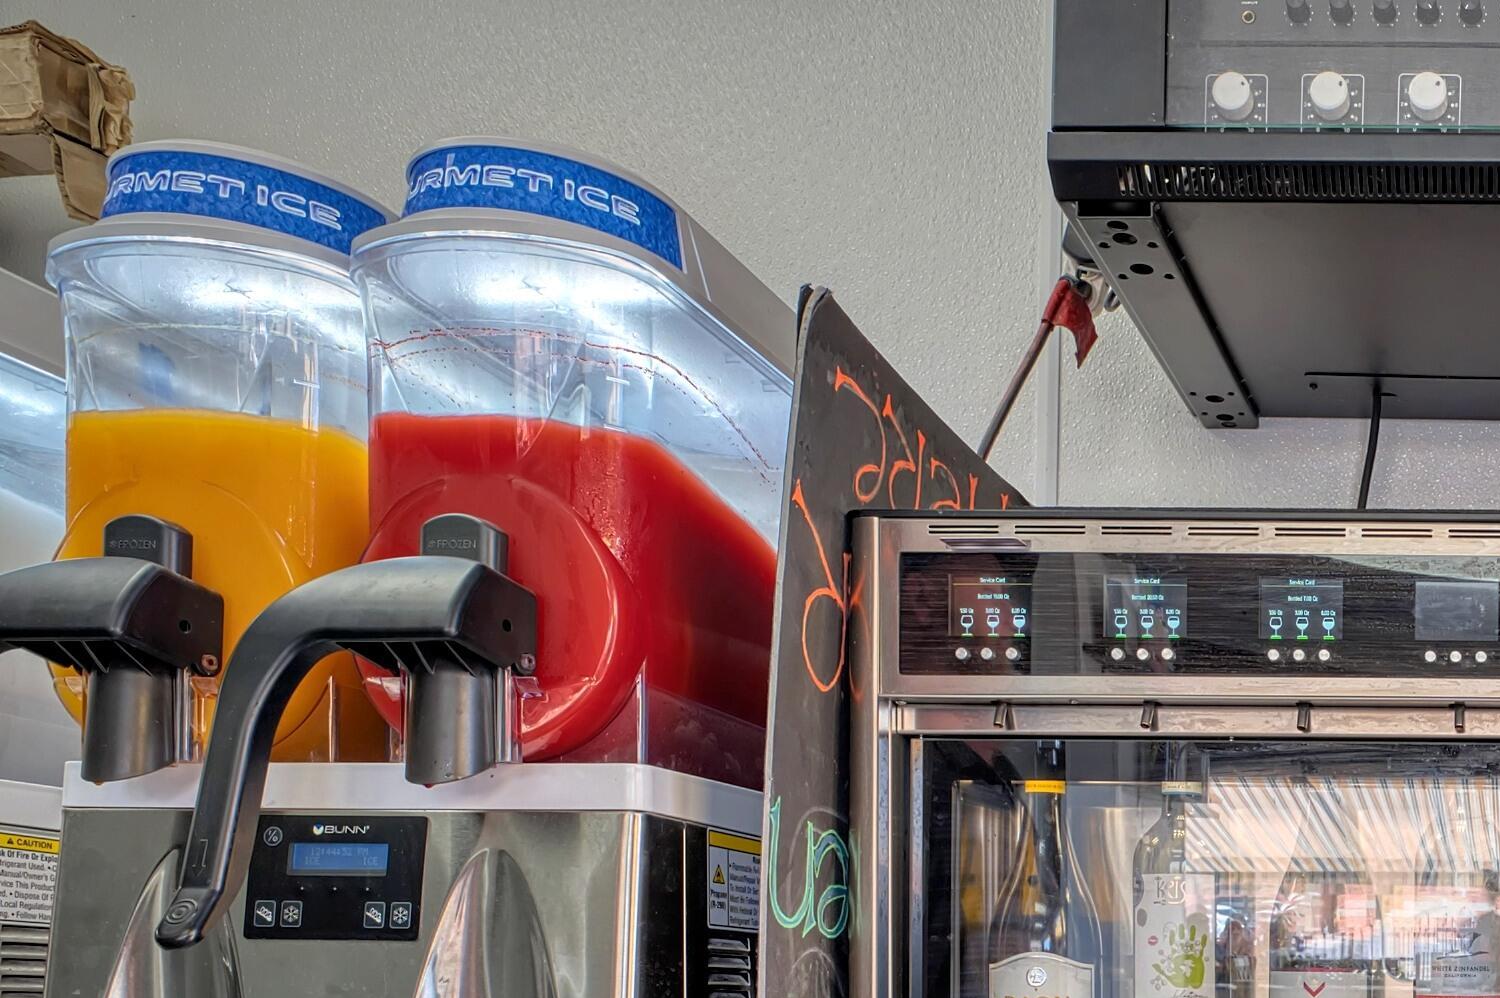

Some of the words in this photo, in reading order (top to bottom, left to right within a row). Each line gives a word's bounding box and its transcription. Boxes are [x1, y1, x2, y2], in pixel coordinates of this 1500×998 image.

[564, 178, 641, 226] ICE
[257, 185, 342, 231] ICE
[325, 825, 367, 834] BUNN
[16, 838, 53, 849] CAUTION
[16, 851, 29, 859] Fire
[305, 857, 320, 865] ICE
[363, 857, 378, 865] ICE
